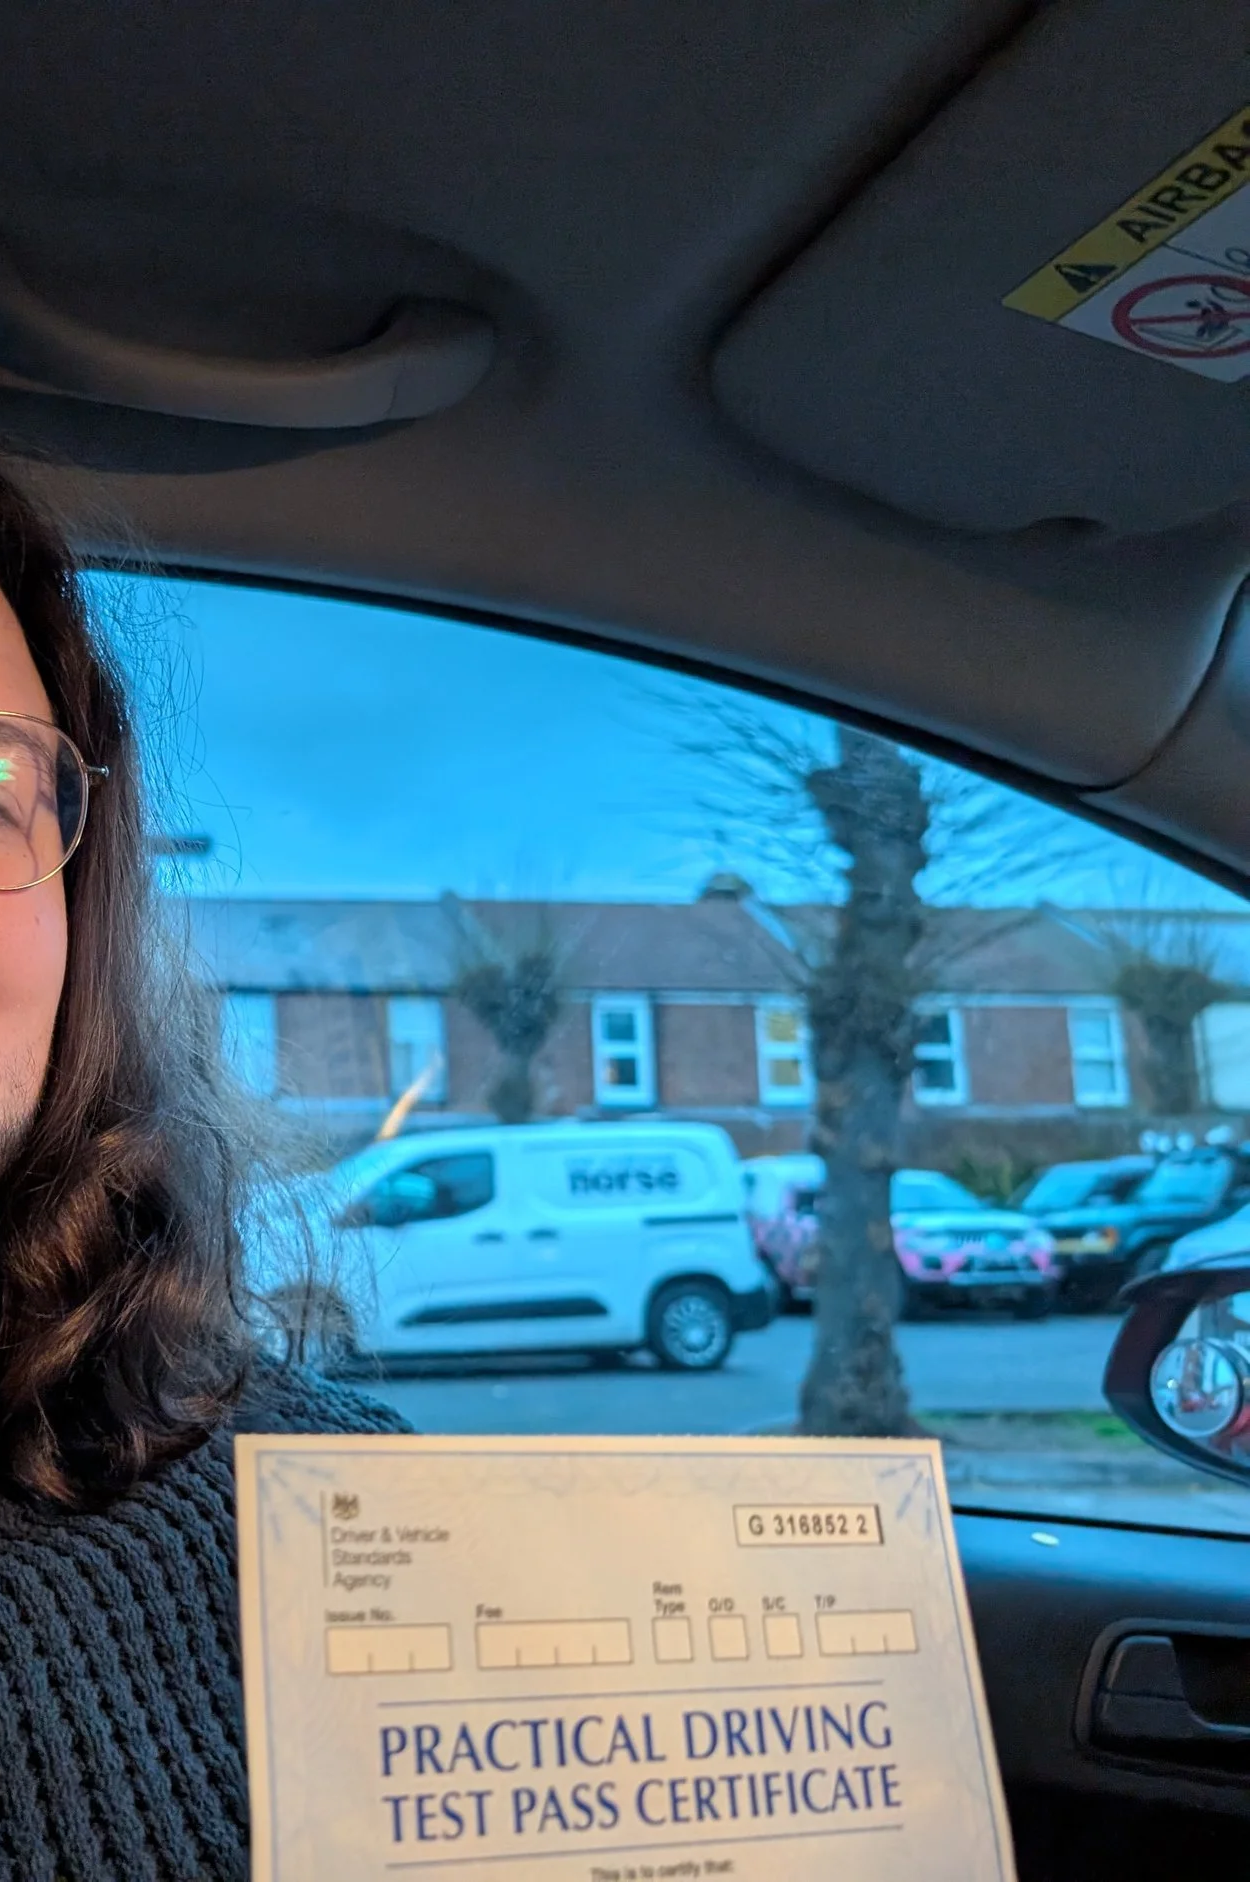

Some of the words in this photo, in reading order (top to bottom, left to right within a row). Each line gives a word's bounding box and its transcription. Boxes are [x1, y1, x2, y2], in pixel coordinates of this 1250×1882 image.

[569, 1171, 678, 1194] norse
[331, 1526, 376, 1543] Driver
[381, 1526, 392, 1543] &
[396, 1525, 449, 1543] Vehicle
[748, 1514, 764, 1536] G
[773, 1514, 848, 1536] 316852
[857, 1514, 868, 1535] 2
[332, 1549, 412, 1566] Standards
[333, 1571, 392, 1591] Agency
[324, 1609, 366, 1622] Issue
[476, 1604, 503, 1619] Fee
[654, 1600, 686, 1615] Type
[379, 1713, 666, 1777] PRACTICAL
[683, 1700, 893, 1760] DRIVING
[382, 1790, 493, 1843] TEST
[511, 1781, 621, 1834] PASS
[635, 1764, 903, 1826] CERTIFICATE
